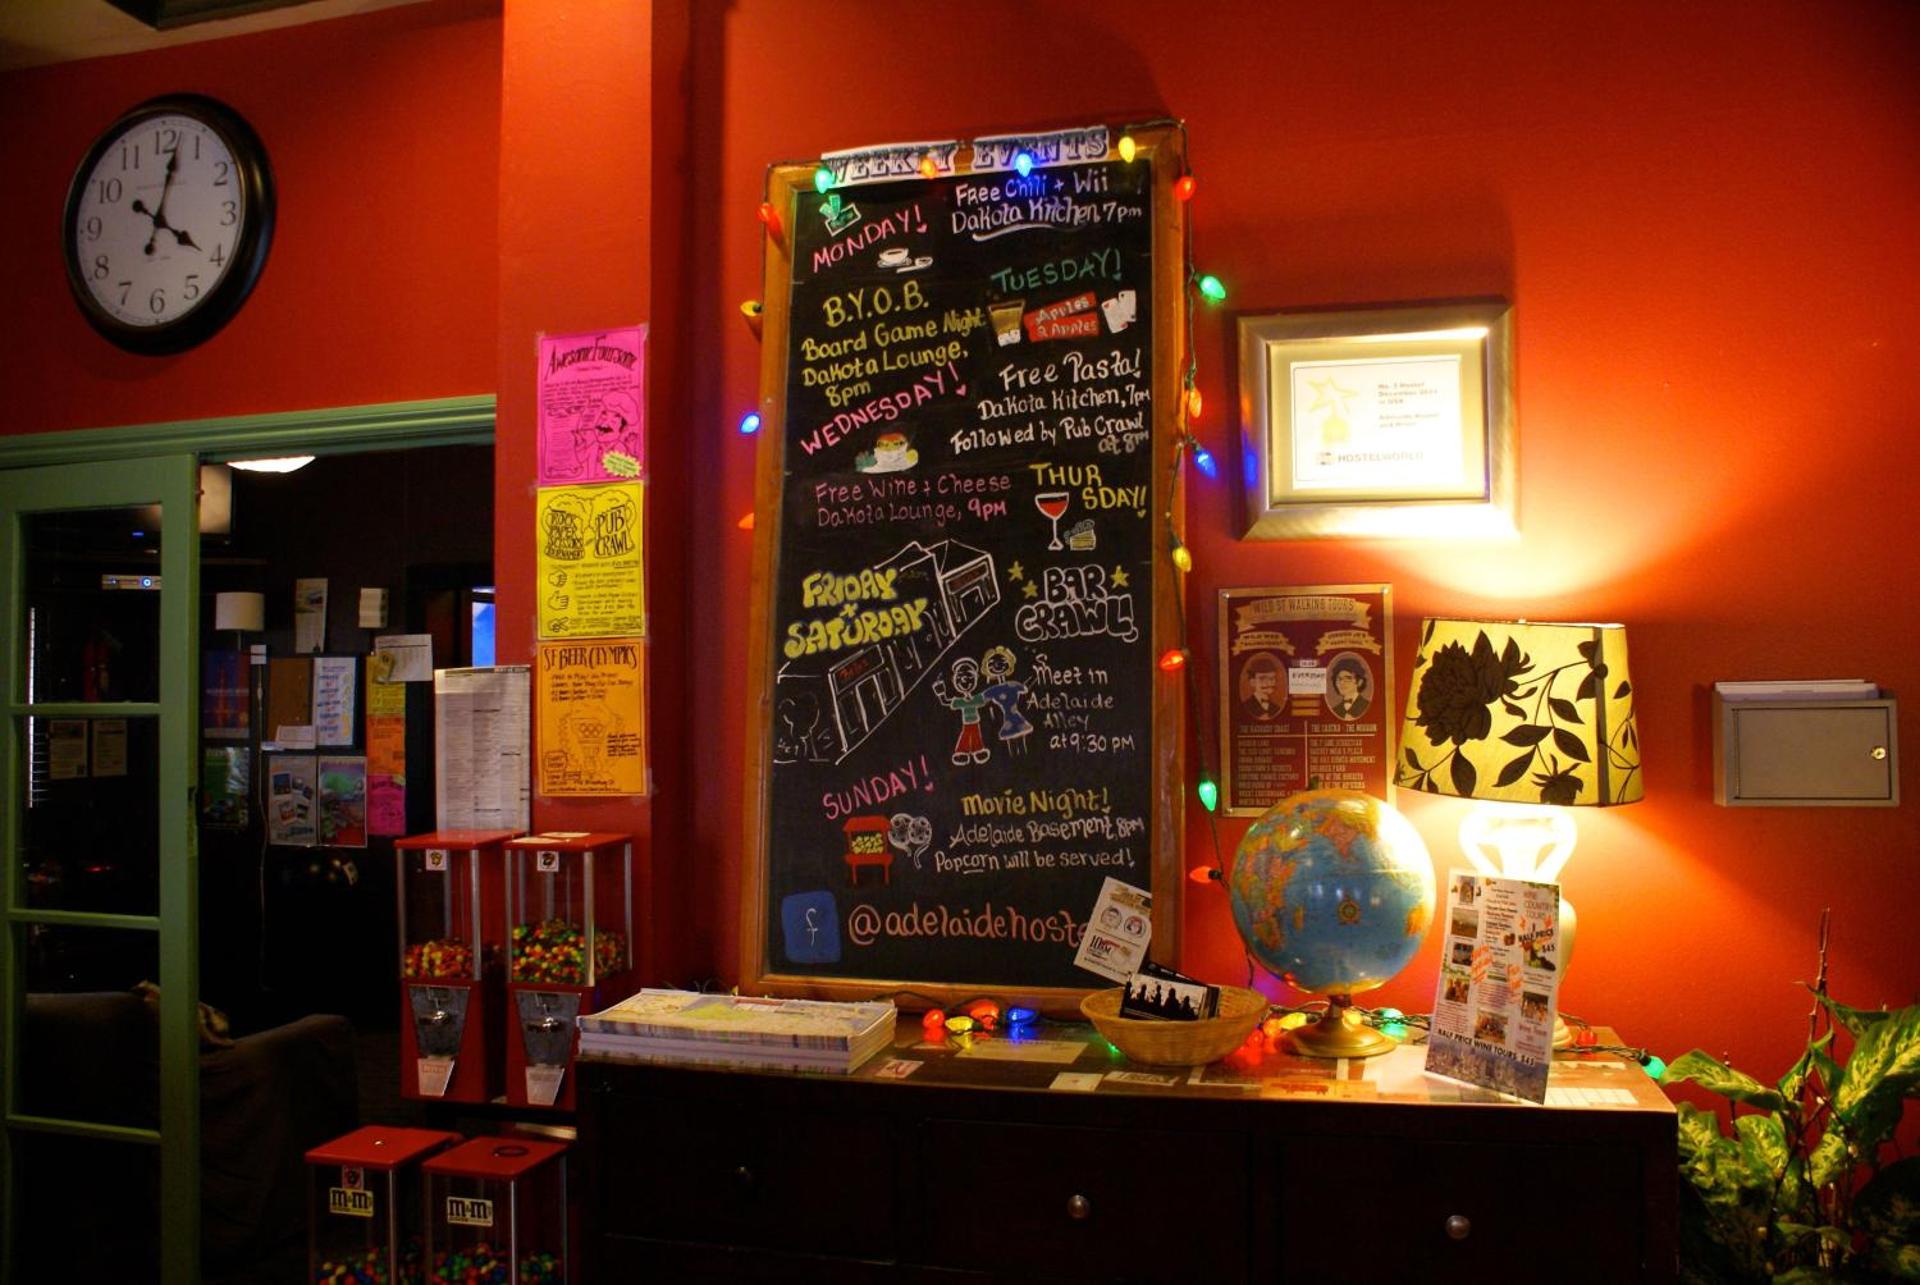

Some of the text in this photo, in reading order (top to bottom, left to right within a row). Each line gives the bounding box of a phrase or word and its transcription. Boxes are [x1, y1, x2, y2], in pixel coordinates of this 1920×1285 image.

[155, 129, 177, 155] 12
[194, 135, 200, 160] 1
[122, 145, 140, 171] 11
[213, 161, 228, 186] 2
[1005, 174, 1047, 199] Chili
[1053, 178, 1065, 193] +
[1073, 166, 1109, 194] Wii
[100, 178, 122, 204] 10
[220, 201, 236, 226] 3
[87, 216, 103, 241] 9
[814, 204, 928, 274] MONDAY!
[94, 255, 109, 279] 8
[210, 243, 225, 267] 4
[989, 247, 1123, 293] TUESDAY!
[118, 280, 132, 306] 7
[150, 288, 165, 314] 6
[184, 275, 199, 300] 5
[822, 279, 930, 328] B.Y.O.B.
[801, 330, 868, 362] Board
[874, 320, 938, 348] Game
[998, 347, 1142, 392] Free Pasta!
[825, 380, 871, 409] 8pm
[801, 361, 968, 456] WEDNESDAY!
[1039, 420, 1057, 447] by
[1059, 417, 1091, 440] Pub
[1093, 411, 1145, 435] Crawl
[1028, 462, 1103, 487] THUR
[814, 483, 865, 504] Free
[868, 476, 918, 498] Wine
[936, 473, 1012, 495] Cheese
[1081, 486, 1148, 519] SDAY!
[802, 567, 899, 609] FRIDAY
[1043, 564, 1108, 601] BAR
[784, 597, 929, 660] SATURDAY
[1088, 667, 1109, 686] in
[1026, 691, 1114, 711] Adelaide
[822, 755, 935, 820] SUNDAY!
[1029, 786, 1113, 820] Night!
[949, 822, 1025, 849] Adelaide
[934, 848, 1136, 873] Popcorn will be served!
